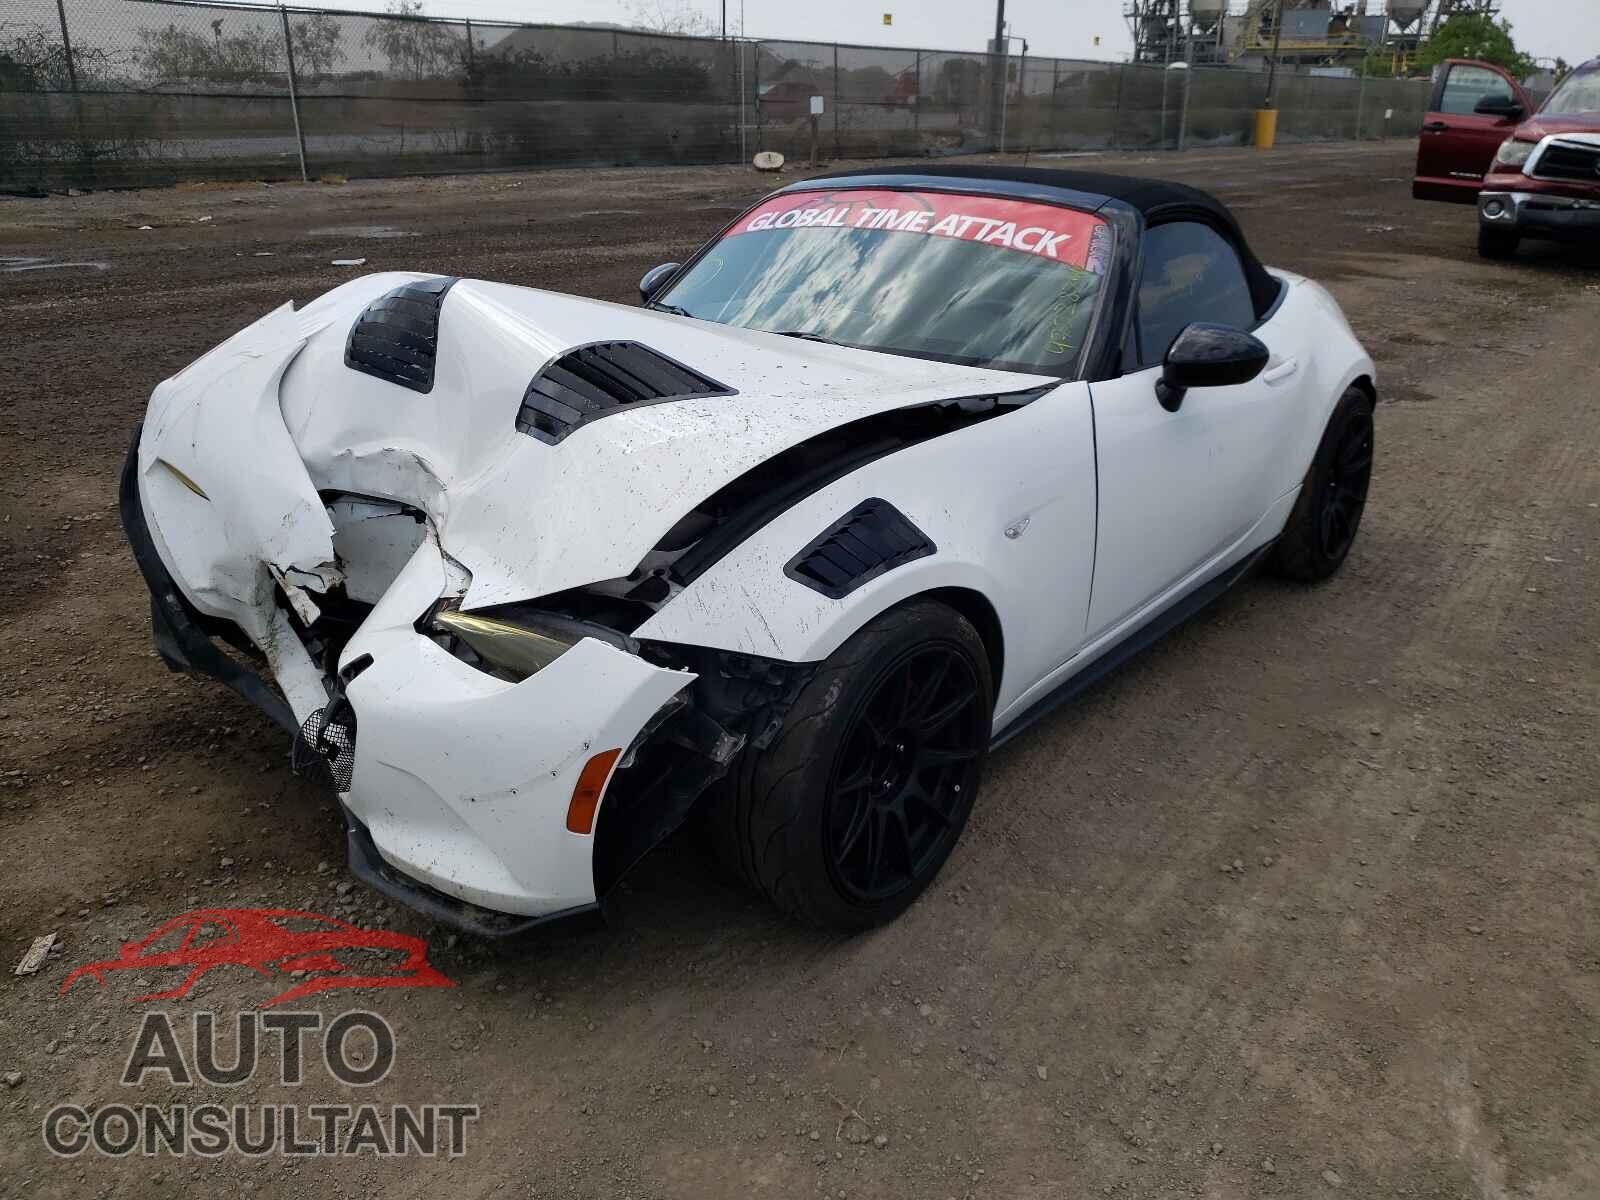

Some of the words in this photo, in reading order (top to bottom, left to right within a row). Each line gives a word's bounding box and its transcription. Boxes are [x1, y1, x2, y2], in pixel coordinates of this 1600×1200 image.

[746, 206, 848, 232] GLOBAL
[854, 207, 935, 233] TIME
[934, 213, 1072, 257] ATTACK
